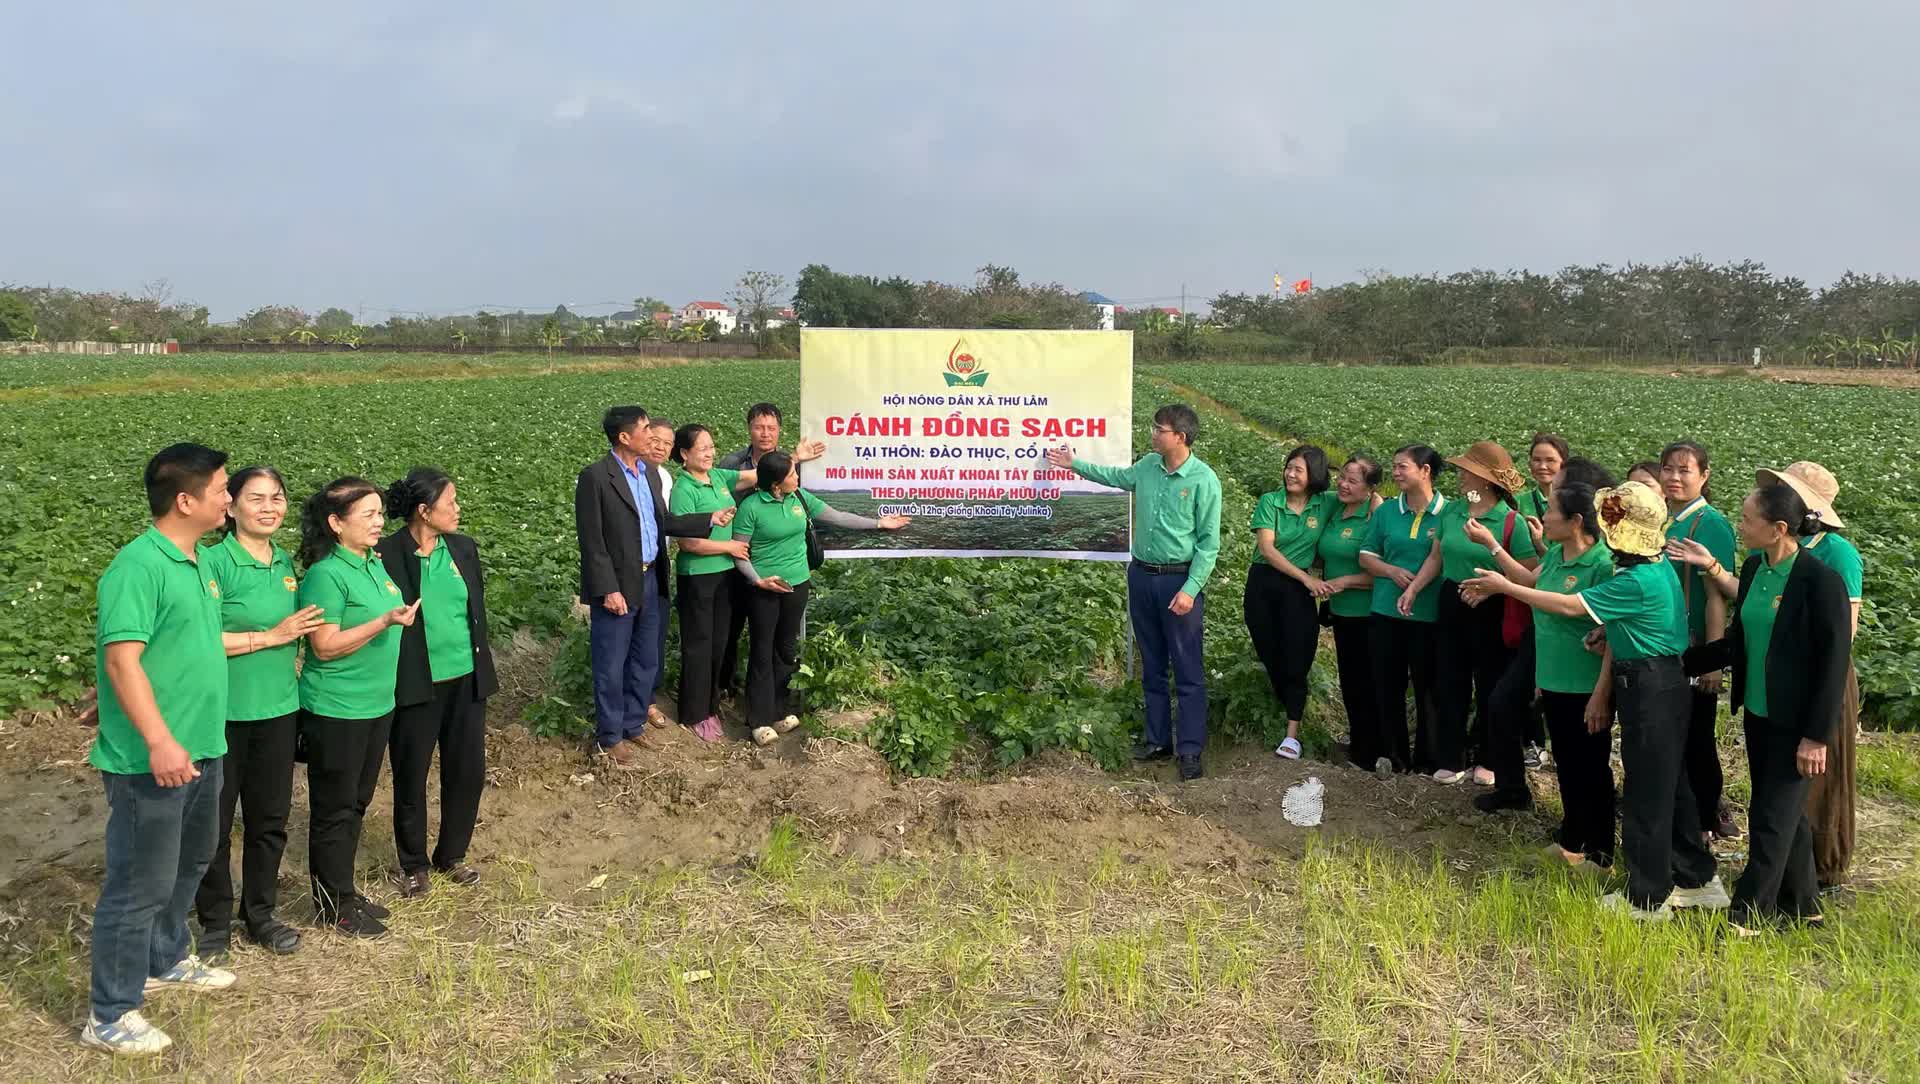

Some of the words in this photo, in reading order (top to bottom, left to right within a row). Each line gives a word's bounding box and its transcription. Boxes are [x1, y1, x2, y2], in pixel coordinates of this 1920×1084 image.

[883, 394, 905, 407] HỘI
[908, 394, 945, 406] NÔNG
[948, 394, 974, 406] DÂN
[977, 395, 994, 406] XÃ
[998, 396, 1020, 406] THƯ
[1023, 395, 1048, 406] LÂM
[825, 412, 911, 436] CÁNH
[922, 410, 1010, 437] ĐỒNG
[1021, 418, 1106, 442] SẠCH
[855, 446, 876, 460] TẠI
[881, 444, 925, 458] THÔN:
[929, 444, 962, 458] ĐÀO
[967, 447, 1010, 461] THỤC,
[1015, 442, 1038, 459] CỔ
[825, 466, 847, 479] MÔ
[851, 466, 884, 479] HÌNH
[888, 465, 916, 480] SẢN
[920, 465, 955, 480] XUẤT
[959, 469, 1000, 481] KHOAI
[1004, 467, 1029, 480] TÂY
[1033, 465, 1075, 481] GIỐNG
[871, 487, 905, 499] THEO
[909, 487, 964, 499] PHƯƠNG
[969, 486, 1005, 500] PHÁP
[1041, 487, 1060, 500] CƠ
[879, 505, 901, 517] (QUY
[903, 503, 920, 515] MÔ:
[948, 504, 973, 518] Giống
[976, 506, 1000, 516] Khoai
[1017, 506, 1052, 518] Julinka)
